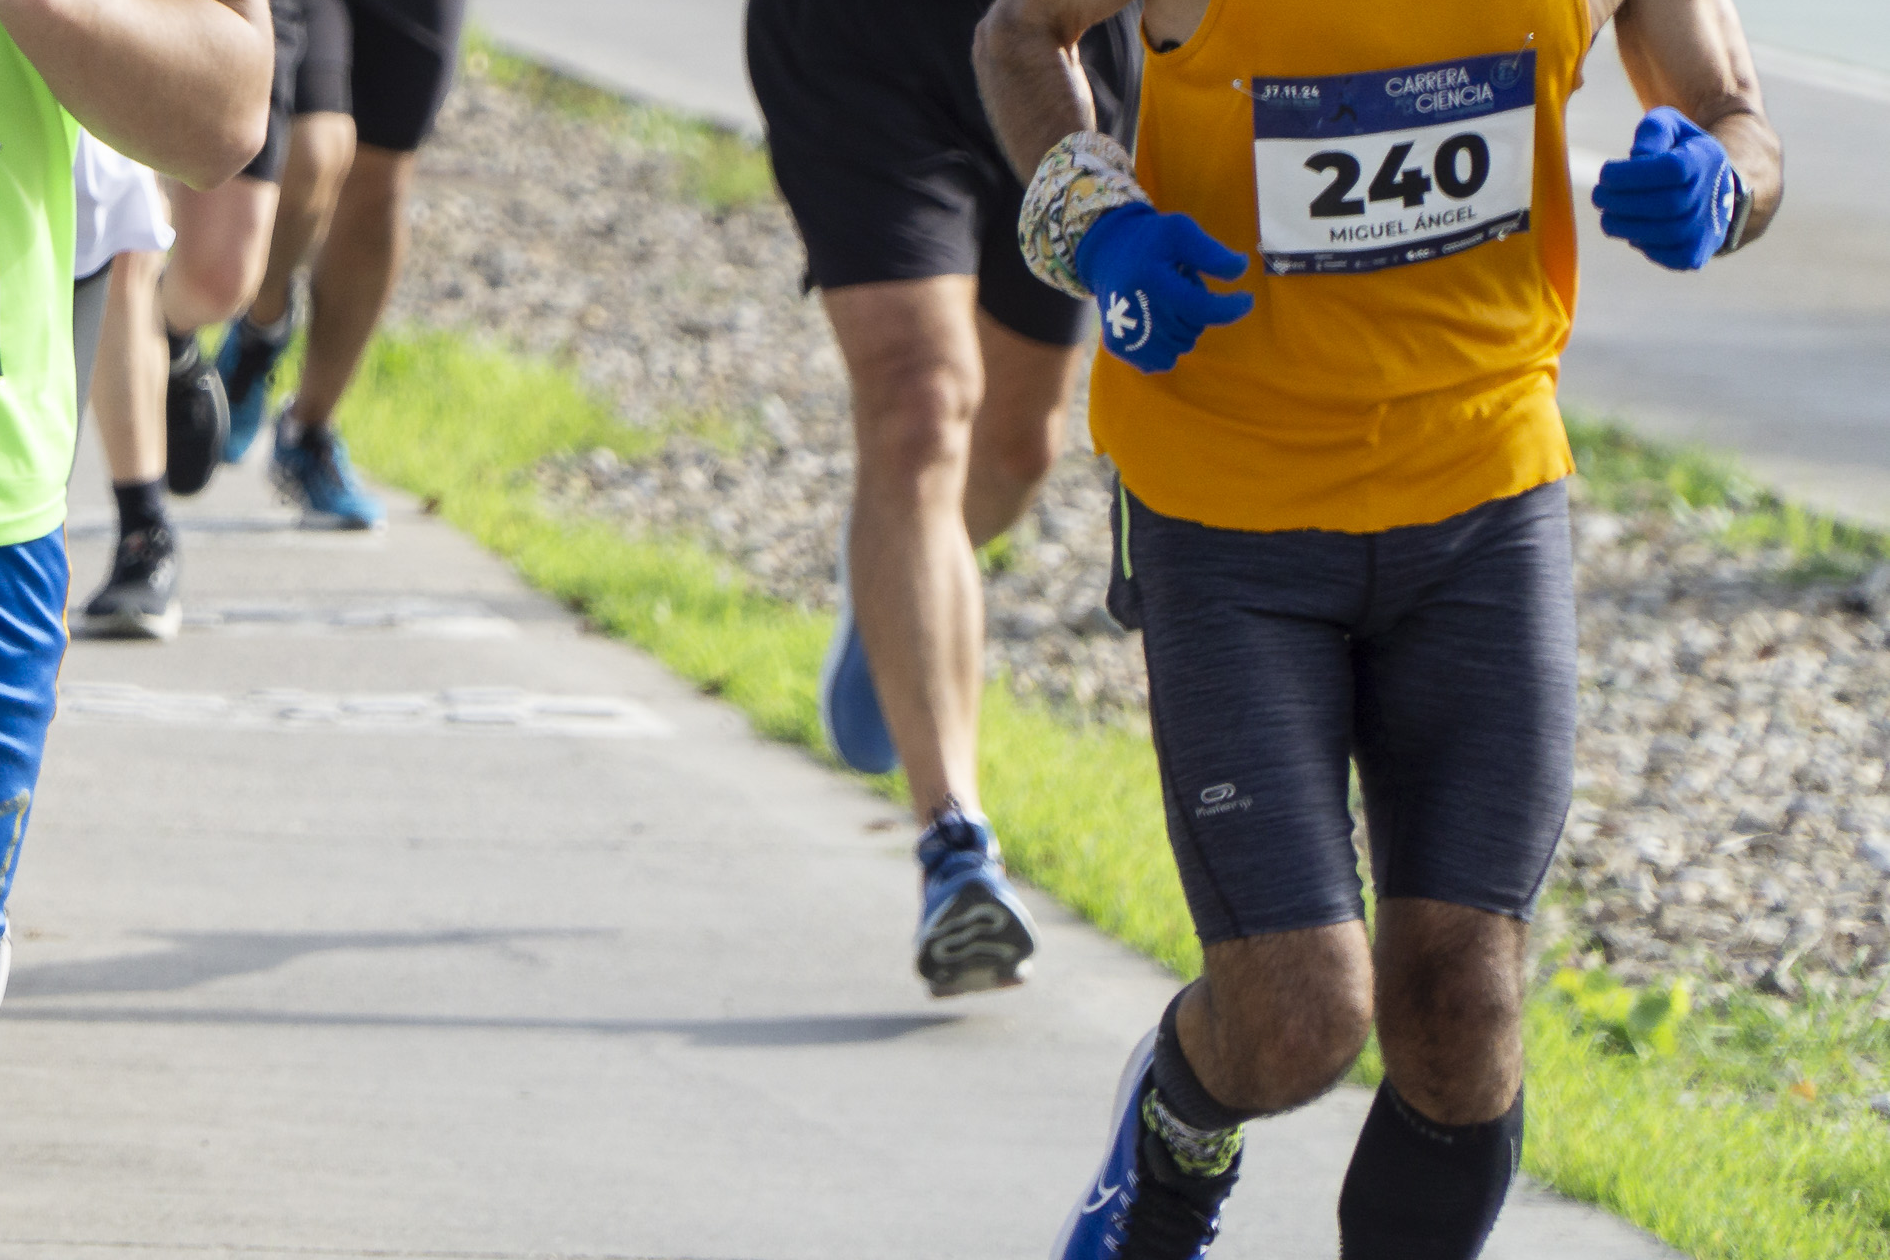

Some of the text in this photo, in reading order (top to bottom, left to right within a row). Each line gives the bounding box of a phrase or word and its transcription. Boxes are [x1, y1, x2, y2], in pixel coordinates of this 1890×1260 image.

[1385, 66, 1470, 98] CARRERA
[1415, 82, 1494, 113] CIENCIA
[1303, 131, 1491, 219] 240
[1328, 219, 1408, 243] MIGUEL
[1413, 204, 1478, 232] ÁNGEL
